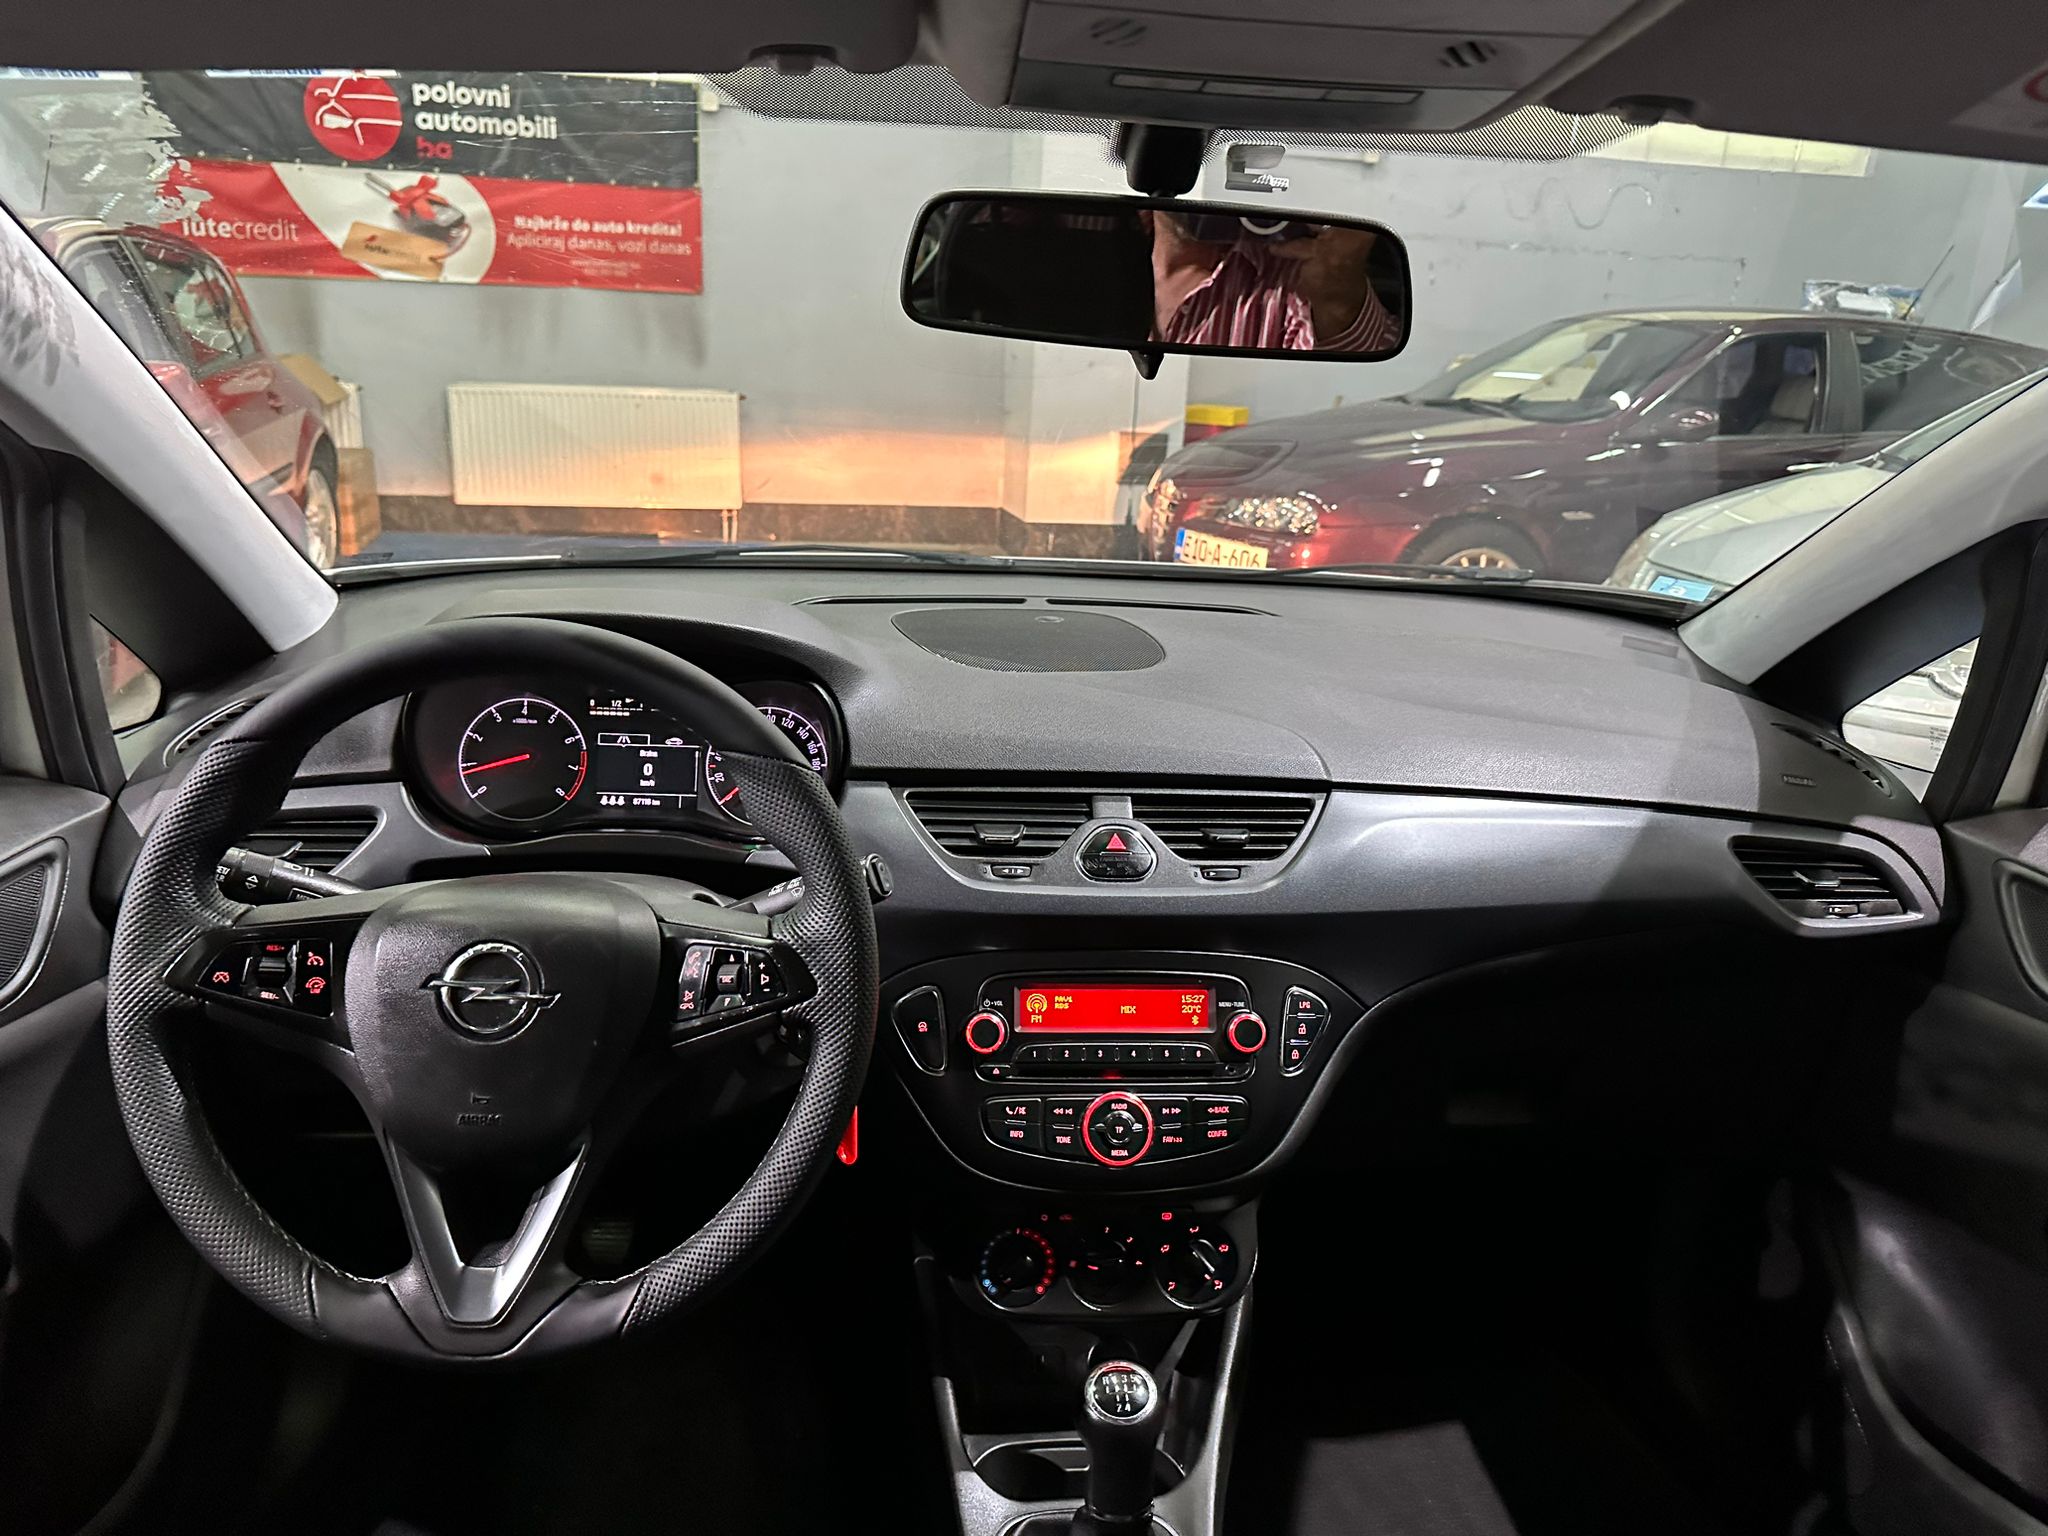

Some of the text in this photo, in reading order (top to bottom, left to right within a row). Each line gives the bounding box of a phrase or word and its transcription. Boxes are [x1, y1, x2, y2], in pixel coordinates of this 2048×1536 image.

[411, 80, 511, 108] polovni
[414, 111, 558, 139] automobili
[592, 220, 625, 233] auto
[648, 240, 692, 255] danas
[521, 706, 528, 716] 4
[493, 712, 502, 722] 3
[547, 714, 557, 724] 5
[781, 717, 795, 729] 120
[472, 733, 484, 742] 2
[796, 726, 810, 740] 140
[564, 736, 576, 744] 6
[806, 740, 818, 755] 160
[812, 757, 821, 771] 180
[643, 763, 653, 776] 0
[714, 772, 725, 783] 20
[476, 785, 488, 796] 0
[555, 787, 565, 797] 8
[1181, 995, 1205, 1003] 15:27
[1120, 1005, 1136, 1014] MIX
[1299, 1001, 1311, 1009] LPG
[1031, 1015, 1043, 1023] FM
[1010, 1130, 1024, 1138] INFO
[1207, 1130, 1228, 1138] CONFIG
[1056, 1136, 1071, 1144] TONE
[1121, 1374, 1128, 1383] 3
